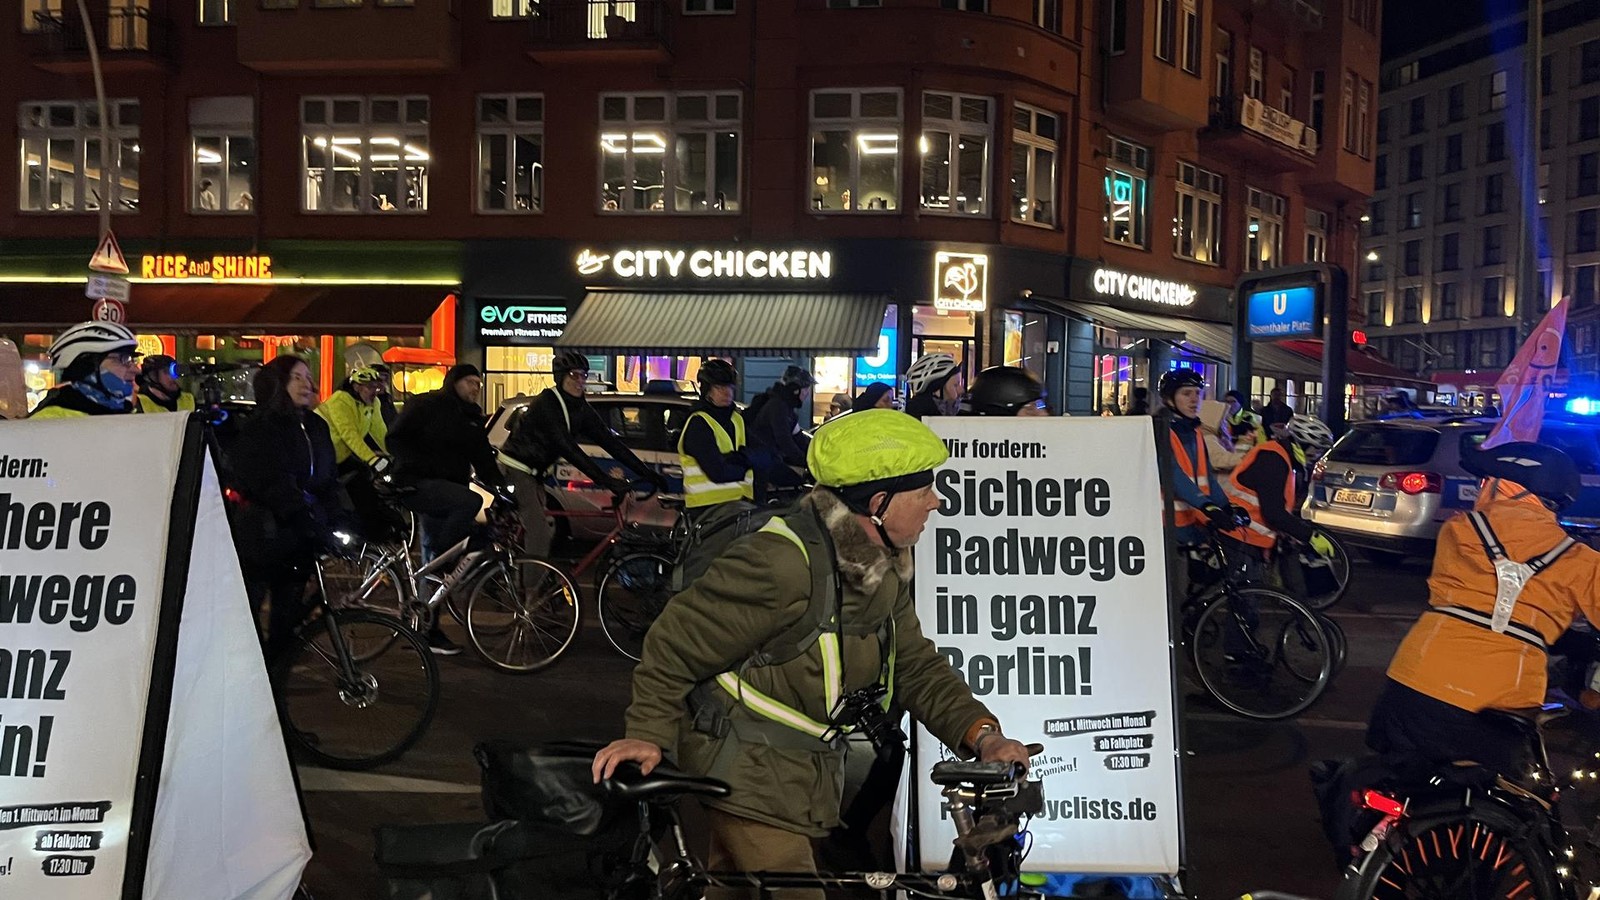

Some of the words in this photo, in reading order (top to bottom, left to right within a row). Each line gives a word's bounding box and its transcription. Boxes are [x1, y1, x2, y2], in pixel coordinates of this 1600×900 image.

[142, 255, 188, 279] RICE
[189, 261, 210, 276] AND
[212, 256, 272, 279] SHINE
[613, 250, 685, 278] CITY
[690, 250, 831, 278] CHICKEN
[1093, 268, 1128, 297] CITY
[1128, 275, 1186, 306] CHICKEN
[1273, 293, 1287, 315] U
[101, 308, 118, 322] 30
[481, 328, 514, 337] Premium
[514, 328, 541, 337] Fitness
[971, 438, 1047, 459] fordern:
[935, 468, 1111, 517] Sichere
[935, 527, 1145, 582] Radwege
[936, 586, 979, 635] in
[990, 594, 1098, 641] ganz
[937, 646, 1093, 696] Berlin!
[1047, 720, 1069, 733] Jeden
[1070, 719, 1077, 731] 1.
[1076, 717, 1111, 731] Mittwoch
[1112, 716, 1122, 729] im
[1122, 715, 1147, 728] Monat
[1100, 738, 1110, 750] ab
[1110, 737, 1144, 750] Falkplatz
[1035, 757, 1078, 780] Coming!
[1110, 756, 1129, 769] 17:30
[1130, 756, 1144, 768] Uhr
[13, 808, 20, 823] 1.
[20, 807, 60, 823] Mittwoch
[60, 807, 71, 822] im
[71, 806, 100, 821] Monat
[41, 834, 53, 849] ab
[53, 833, 92, 850] Falkplatz
[50, 858, 71, 874] 17:30
[72, 859, 88, 874] Uhr
